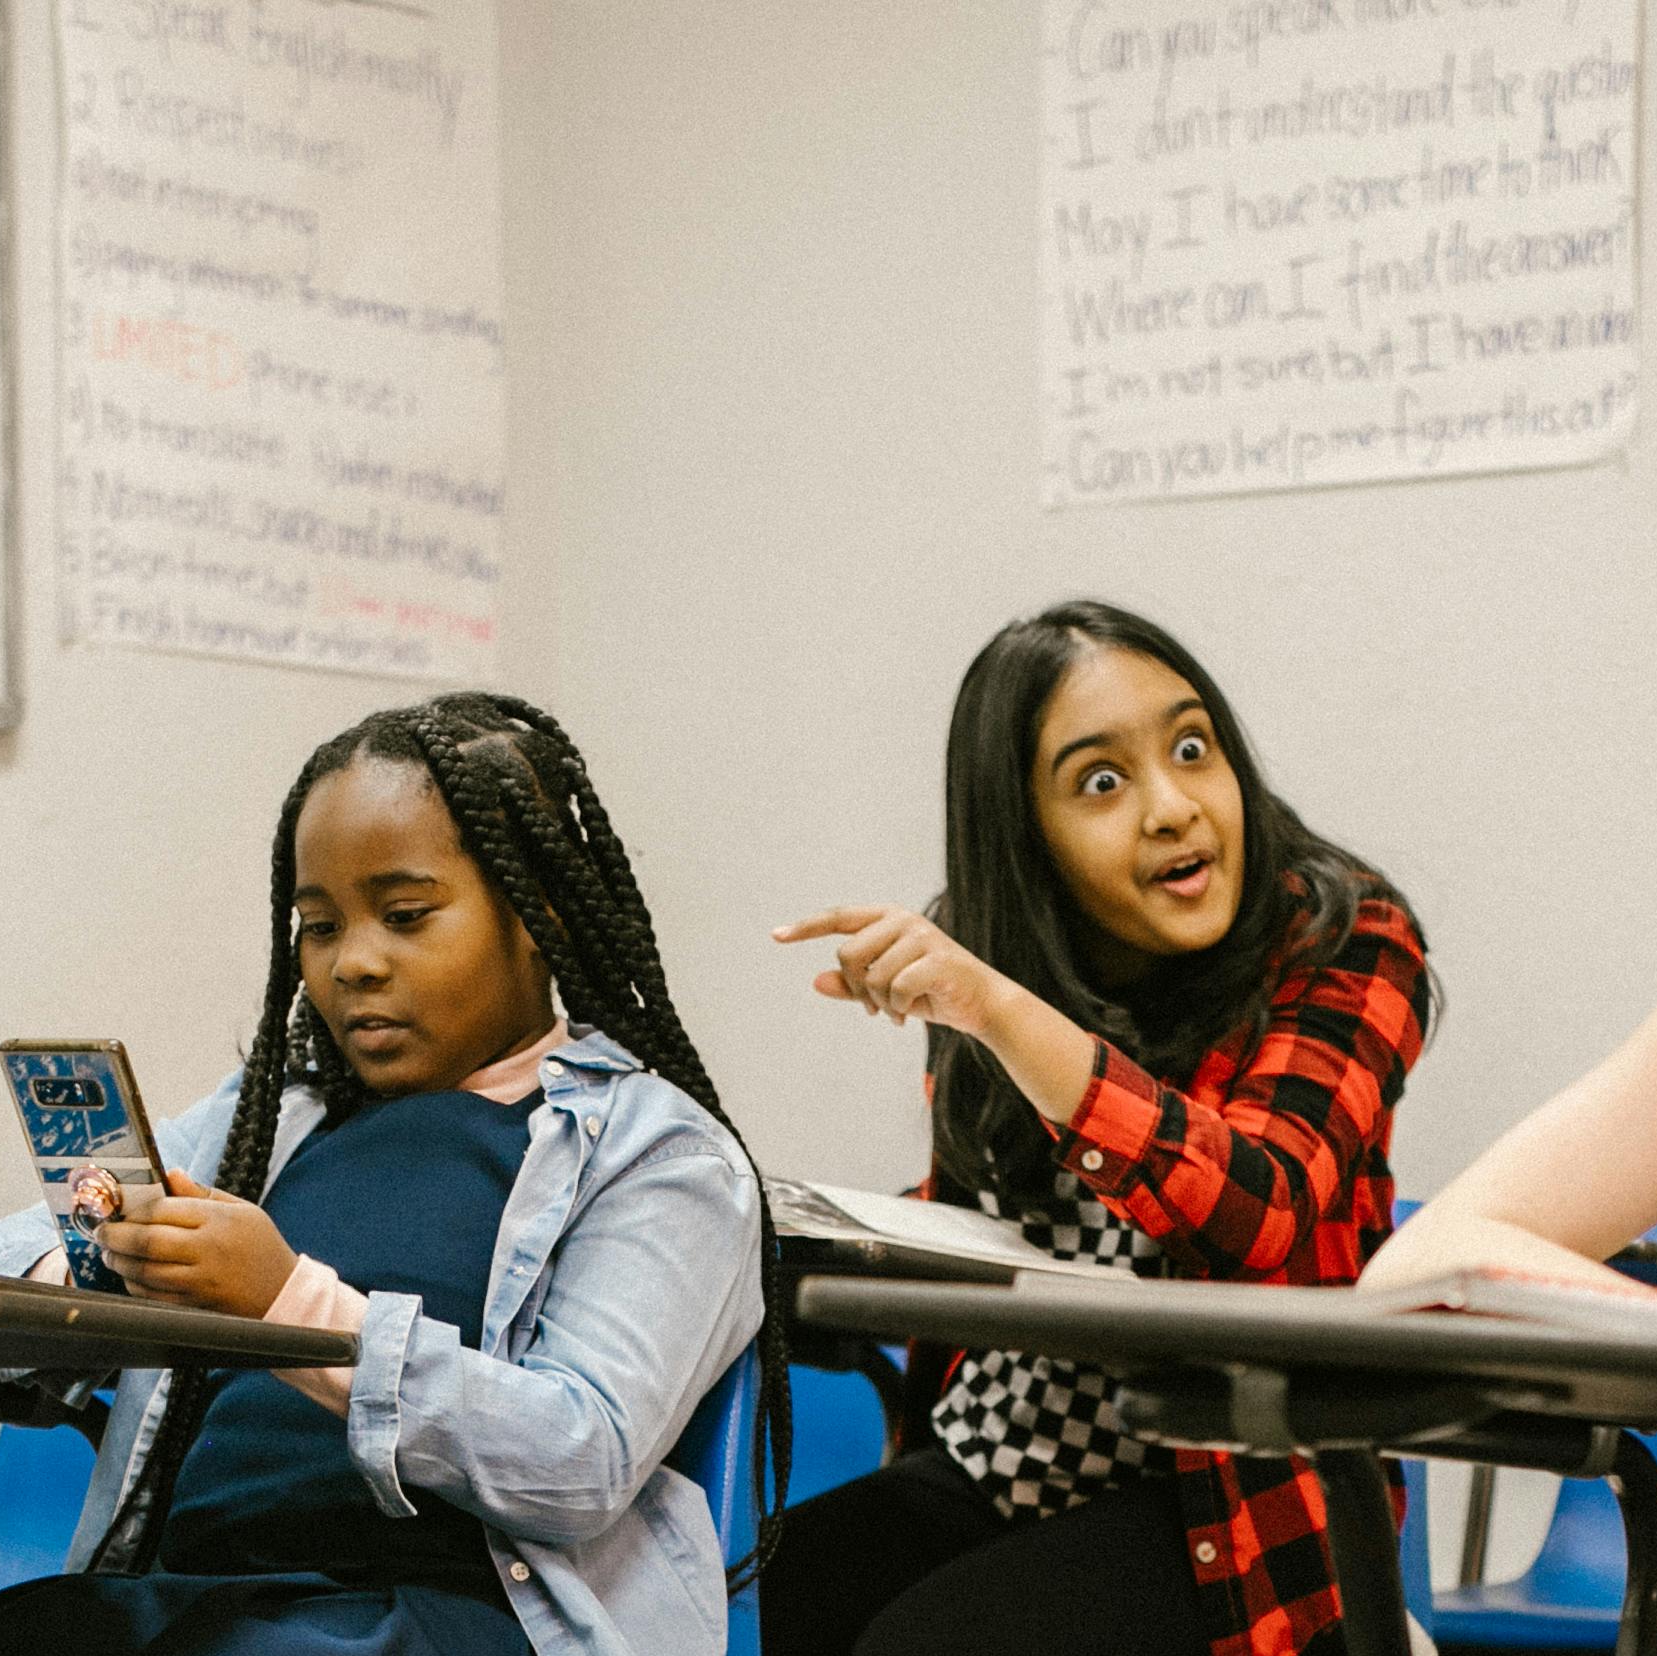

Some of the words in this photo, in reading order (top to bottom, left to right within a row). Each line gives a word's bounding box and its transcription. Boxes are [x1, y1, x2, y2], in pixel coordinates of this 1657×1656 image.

[1064, 99, 1112, 171] I
[1053, 200, 1152, 280] May
[1164, 184, 1208, 249] I
[1063, 278, 1195, 347] Where
[1275, 252, 1326, 323] I
[1159, 352, 1222, 398] not
[1406, 313, 1447, 375] I
